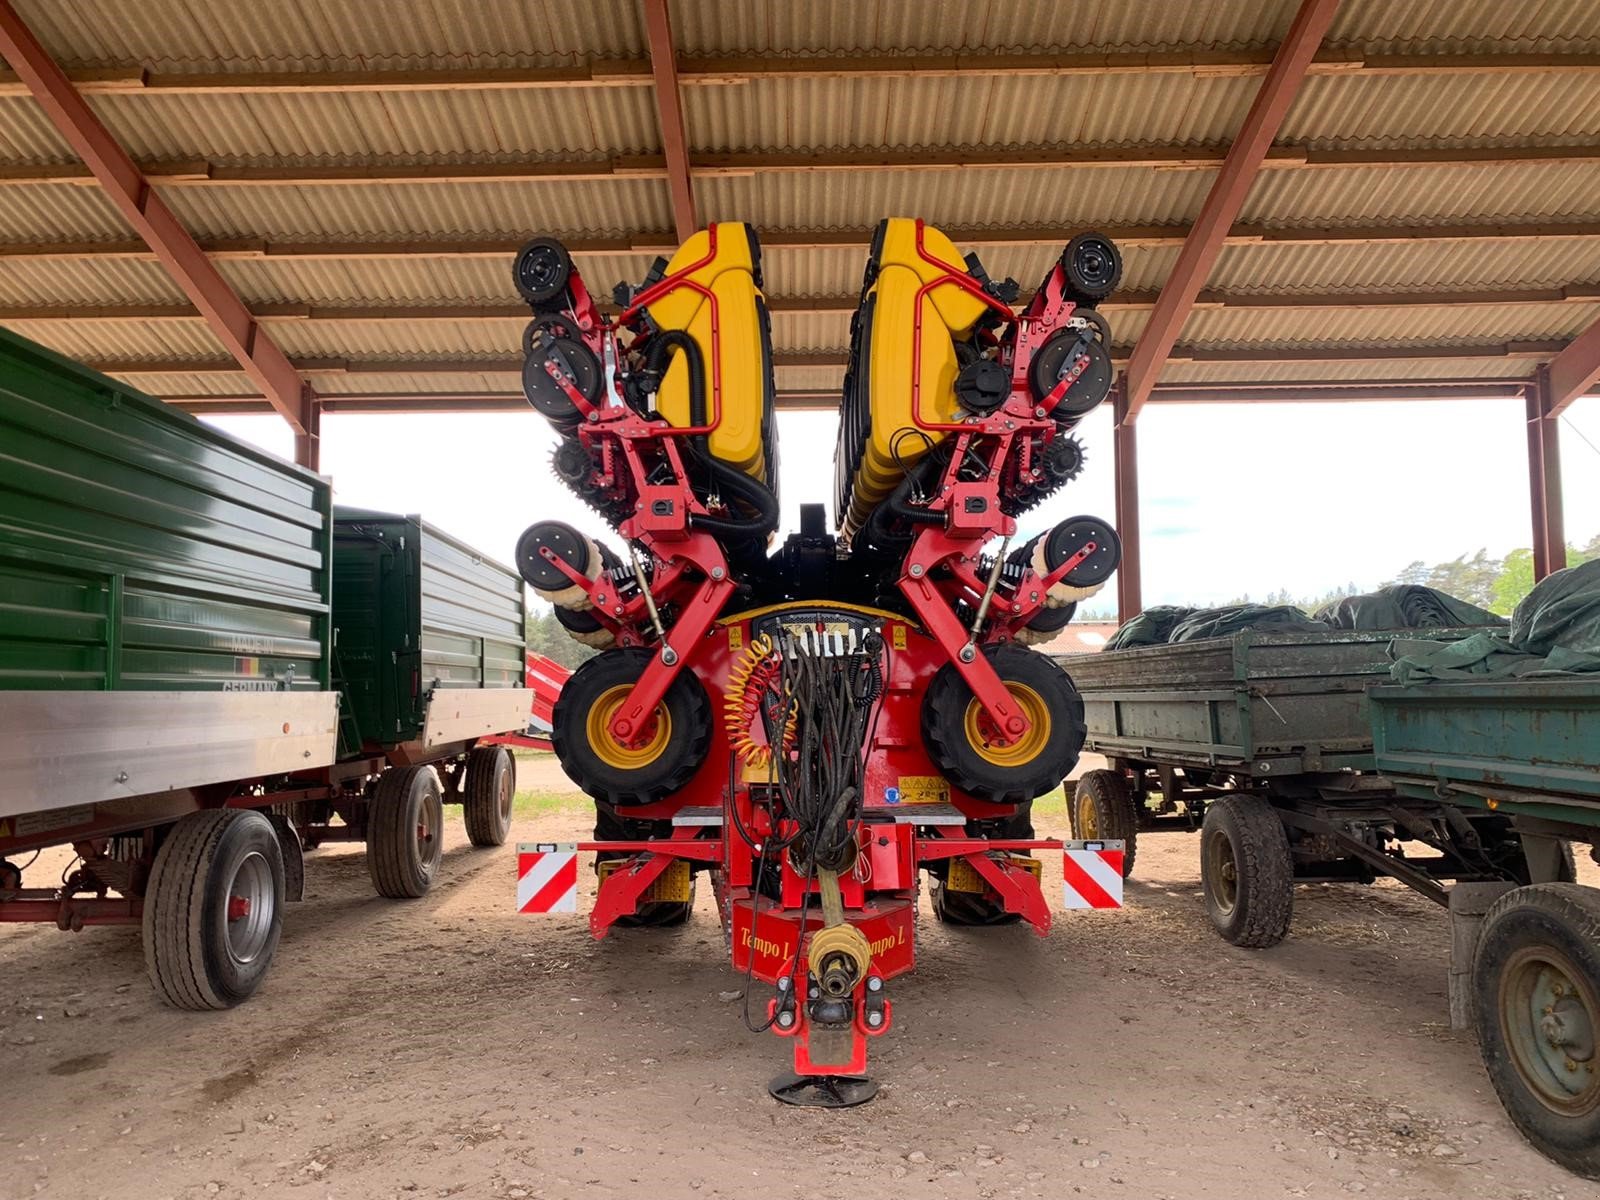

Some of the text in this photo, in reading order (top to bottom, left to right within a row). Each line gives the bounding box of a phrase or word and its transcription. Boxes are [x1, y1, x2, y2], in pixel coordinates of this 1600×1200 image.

[741, 927, 780, 957] Tempo
[868, 926, 906, 957] mpo L
